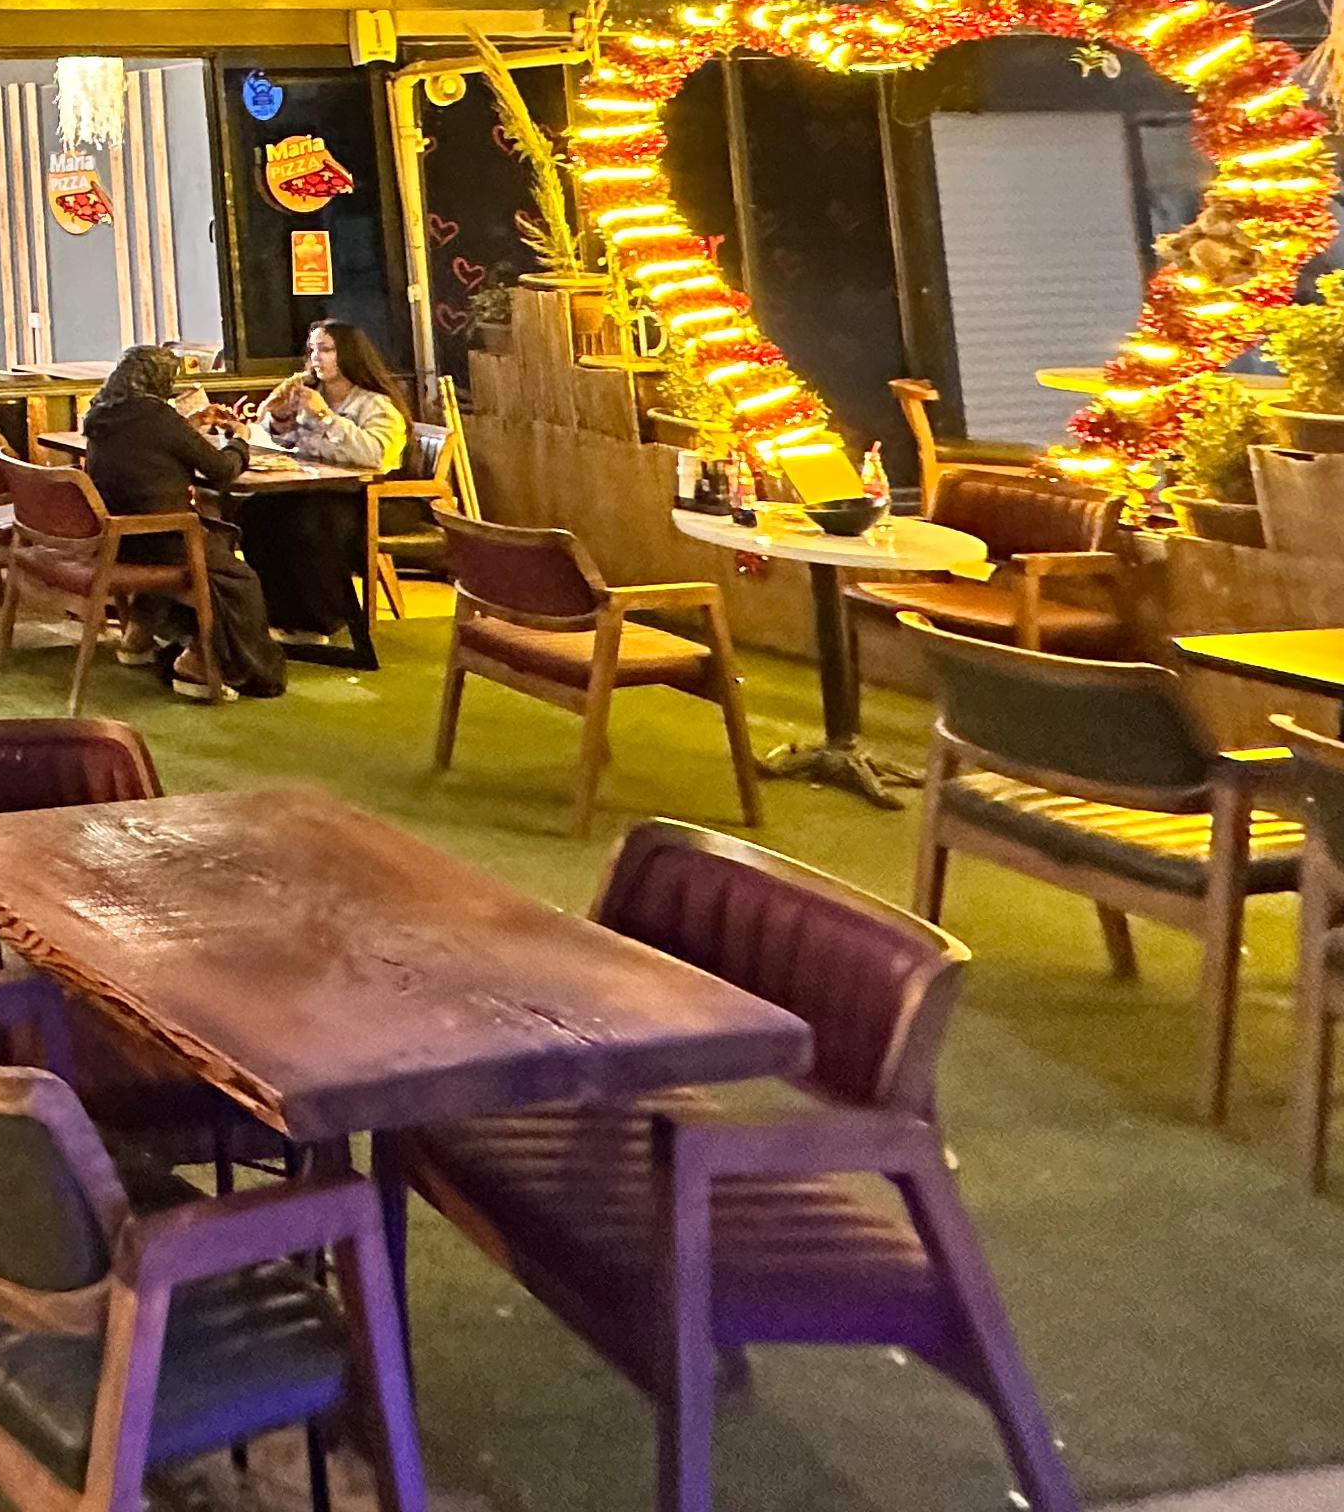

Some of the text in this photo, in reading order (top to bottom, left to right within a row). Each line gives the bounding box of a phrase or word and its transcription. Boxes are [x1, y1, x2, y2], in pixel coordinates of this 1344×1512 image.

[265, 134, 325, 162] Maria
[49, 149, 96, 172] Maria
[269, 157, 322, 180] PIZZA
